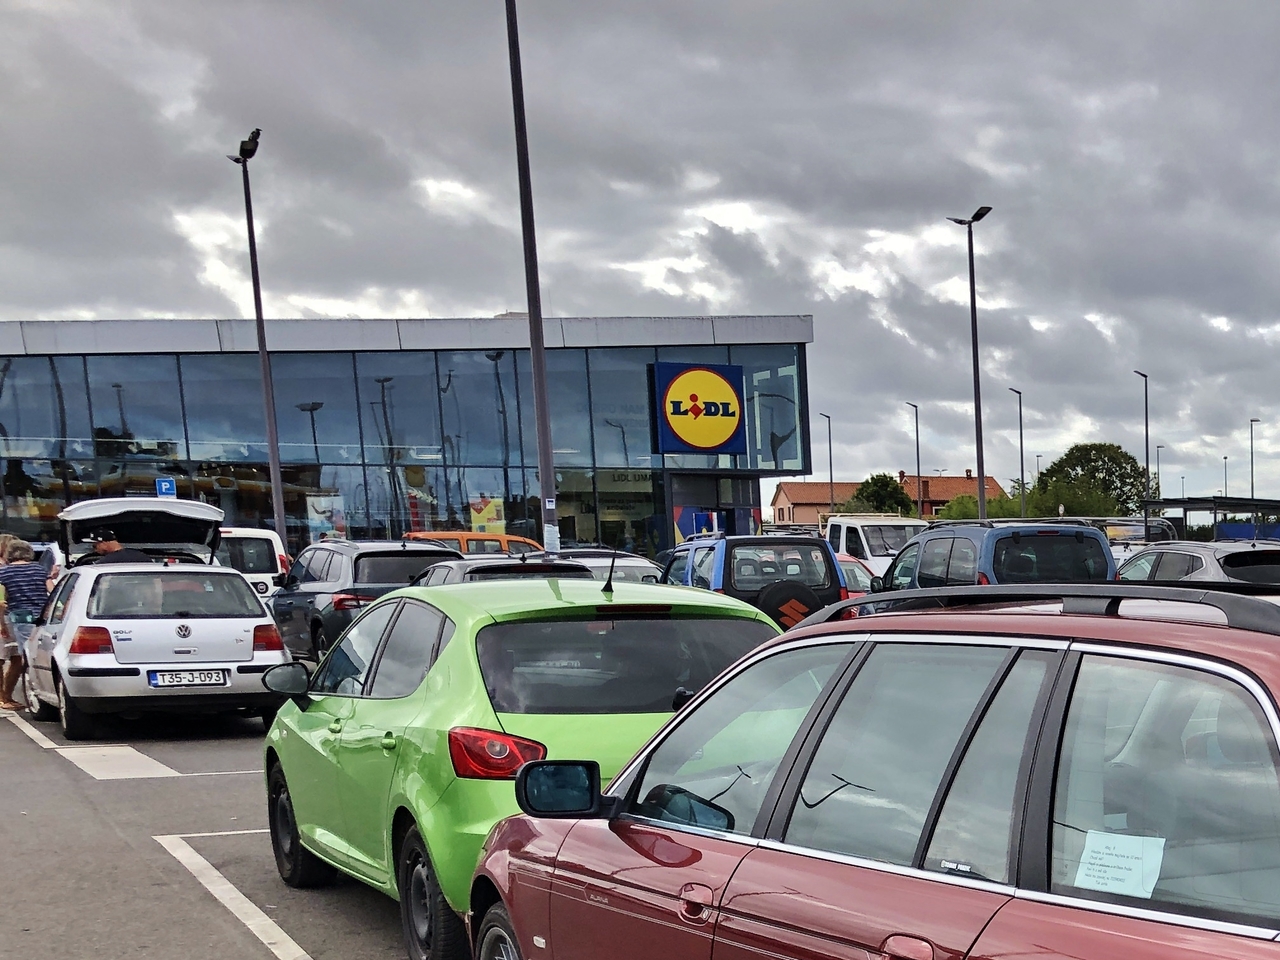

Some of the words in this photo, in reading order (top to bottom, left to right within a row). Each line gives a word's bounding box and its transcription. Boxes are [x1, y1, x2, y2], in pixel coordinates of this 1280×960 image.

[670, 393, 736, 420] LIDL
[161, 482, 170, 493] P
[159, 671, 222, 684] T35-J-093
